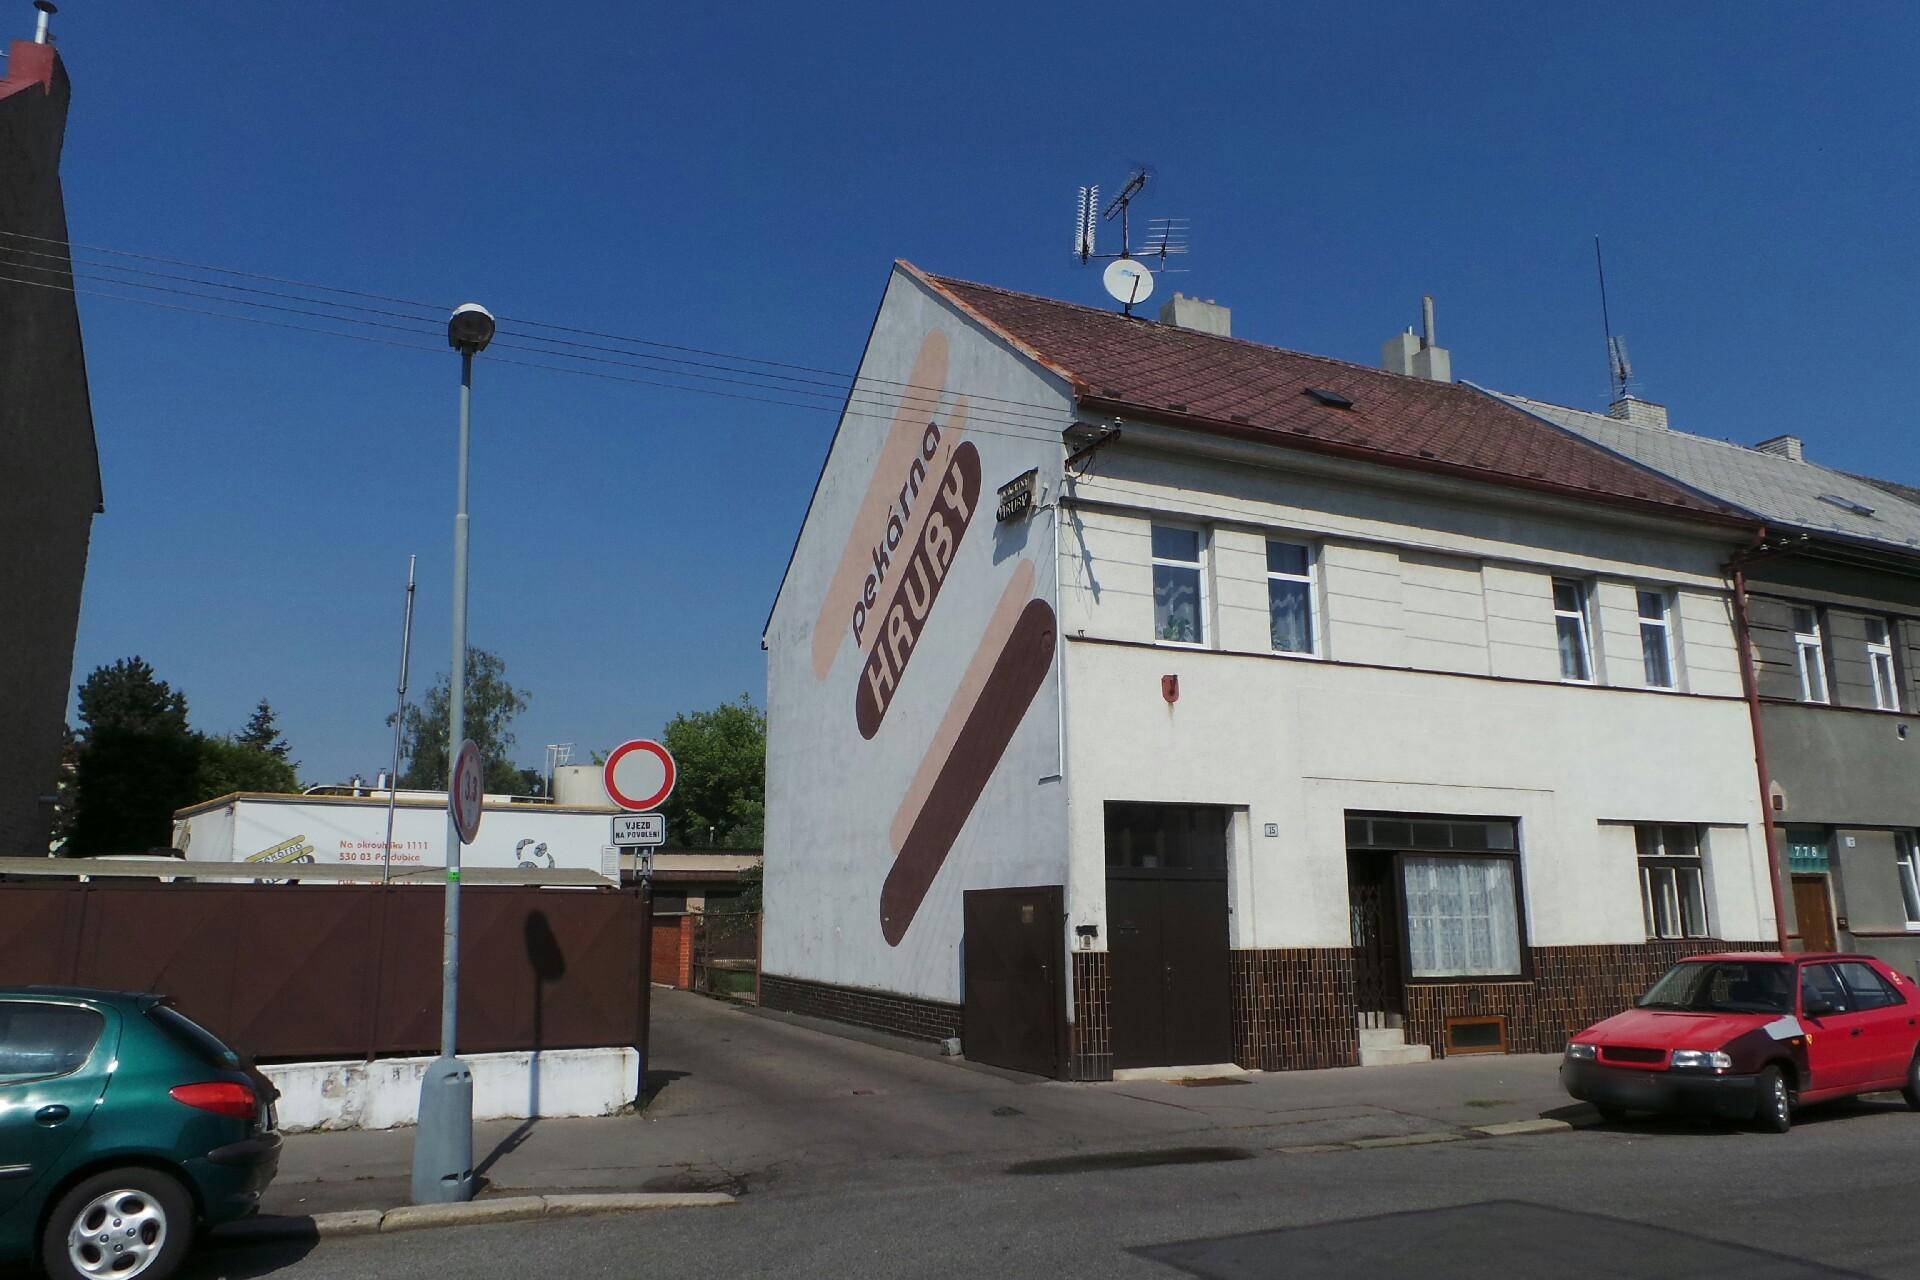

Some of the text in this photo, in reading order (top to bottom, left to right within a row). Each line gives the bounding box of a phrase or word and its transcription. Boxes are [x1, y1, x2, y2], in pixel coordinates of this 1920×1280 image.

[853, 422, 941, 648] pekárna
[625, 821, 651, 829] VJEZD
[340, 841, 353, 849] Na
[407, 842, 428, 850] 1111
[1794, 846, 1817, 857] 778
[339, 853, 421, 861] 530 03 Padubice
